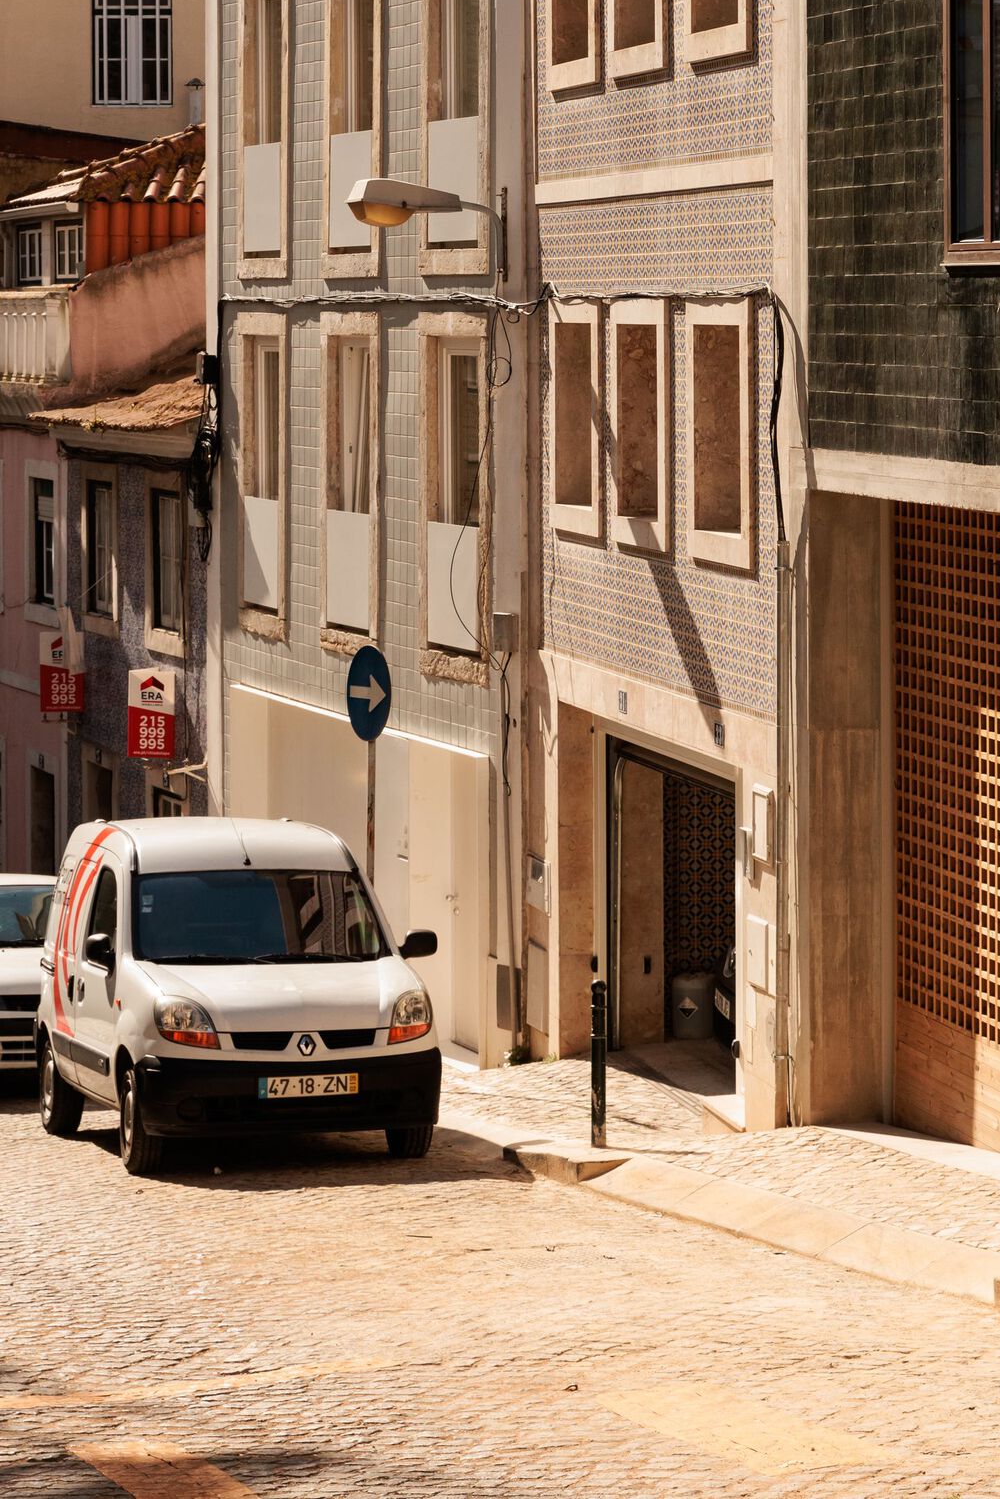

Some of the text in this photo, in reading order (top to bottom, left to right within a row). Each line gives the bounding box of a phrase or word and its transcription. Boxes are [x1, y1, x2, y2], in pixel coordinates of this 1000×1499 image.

[51, 673, 76, 683] 215
[51, 683, 76, 694] 999
[51, 694, 76, 704] 995
[141, 691, 163, 700] ERA
[139, 715, 165, 727] 215
[139, 727, 165, 739] 999
[139, 738, 165, 750] 995
